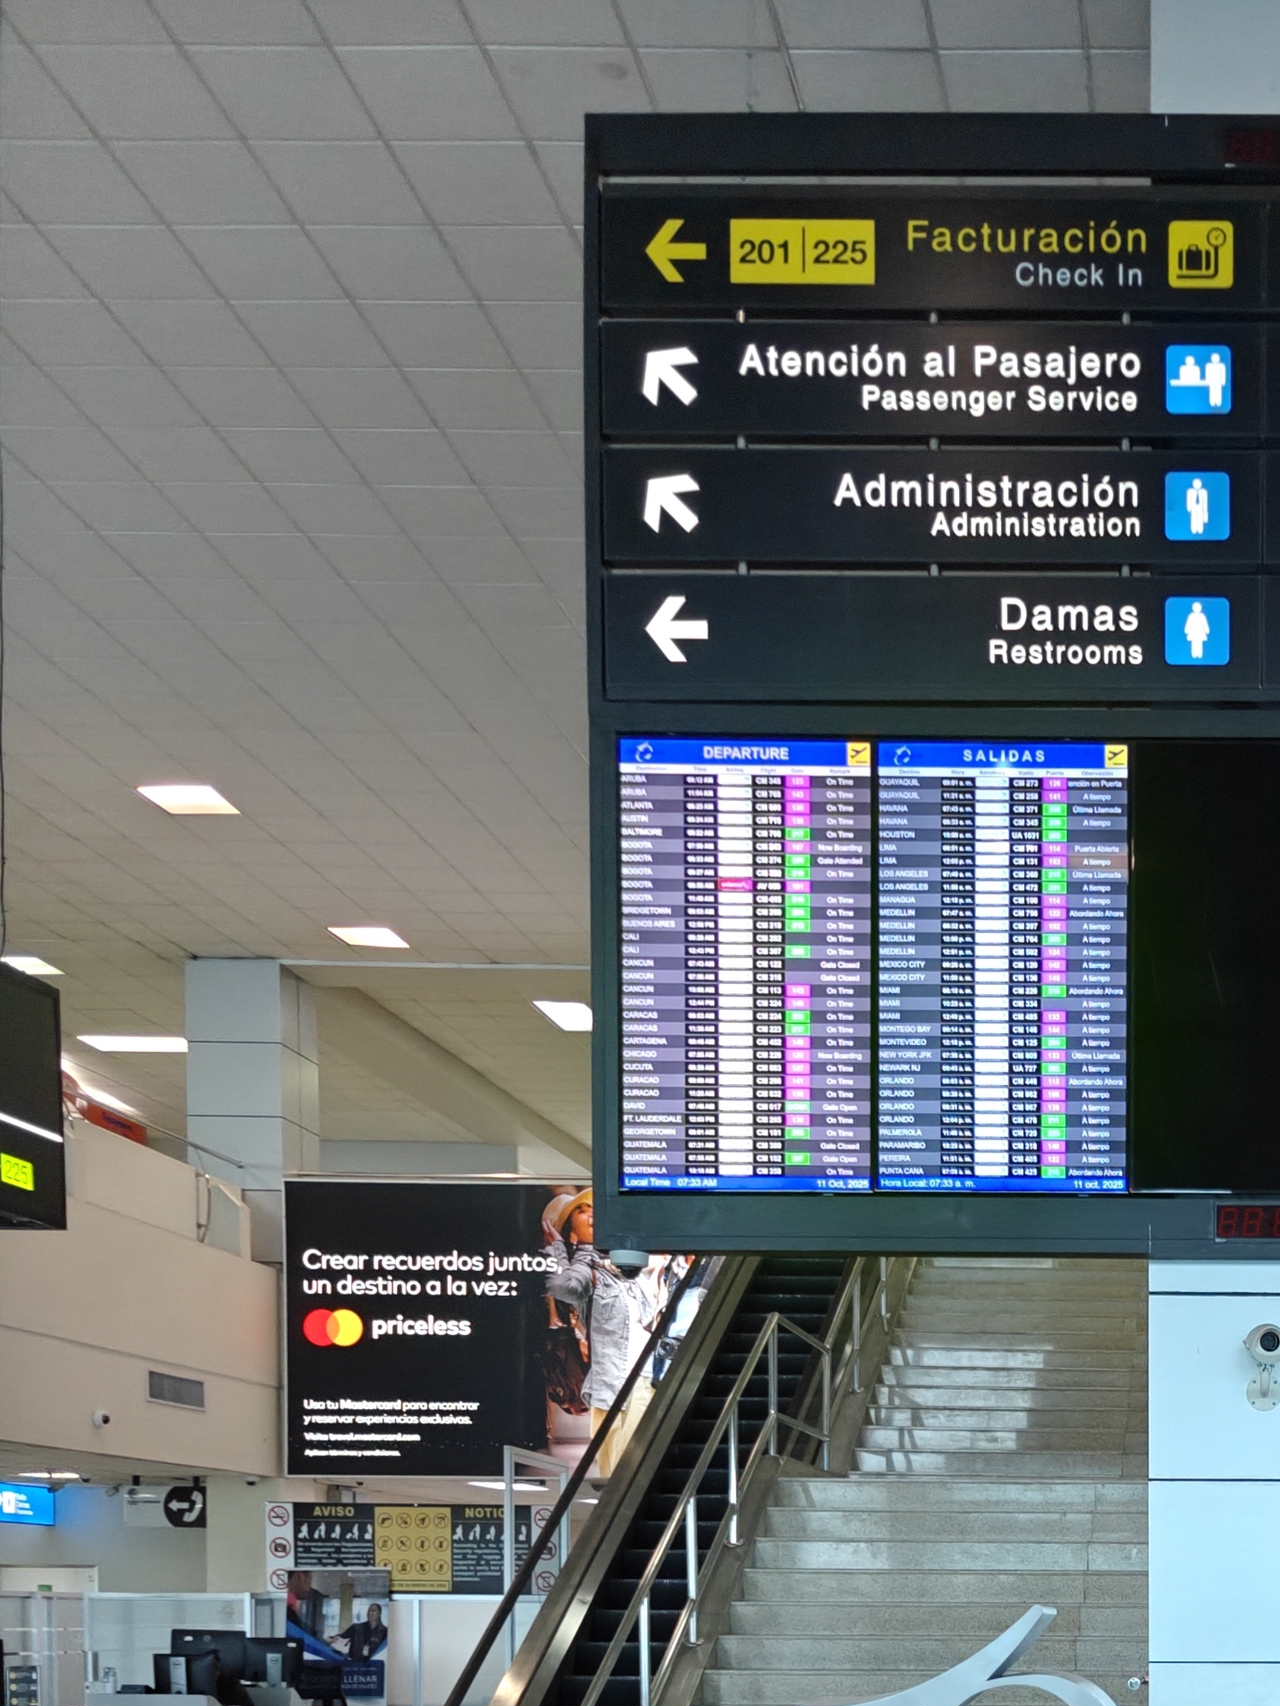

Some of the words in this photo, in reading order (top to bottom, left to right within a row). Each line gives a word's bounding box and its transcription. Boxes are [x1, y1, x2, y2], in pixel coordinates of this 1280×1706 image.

[906, 221, 1147, 253] Facturación
[738, 240, 790, 264] 201
[813, 240, 867, 264] 225
[1016, 263, 1103, 287] Check
[1118, 263, 1142, 287] In
[738, 344, 906, 376] Atención
[924, 346, 956, 376] al
[973, 346, 1141, 383] Pasajero
[861, 386, 1015, 417] Passenger
[1028, 386, 1137, 412] Service
[834, 473, 1138, 508] Administración
[931, 513, 1140, 537] Administration
[1000, 598, 1138, 631] Damas
[989, 640, 1142, 665] Restrooms
[703, 745, 789, 760] DEPARTURE
[963, 749, 1045, 762] SALIDAS
[5, 1160, 27, 1185] 225
[625, 1178, 648, 1187] Local
[651, 1178, 670, 1187] Time
[677, 1178, 701, 1187] 07:33
[703, 1178, 717, 1187] AM
[302, 1249, 368, 1270] Crear
[373, 1250, 484, 1271] recuerdos
[487, 1252, 563, 1276] juntos,
[303, 1278, 332, 1295] un
[337, 1275, 421, 1296] destino
[426, 1280, 441, 1296] a
[447, 1275, 467, 1296] la
[472, 1280, 518, 1296] vez:
[372, 1315, 472, 1340] priceless
[327, 1401, 338, 1410] tu
[340, 1399, 401, 1410] Mastercard
[403, 1402, 428, 1412] para
[429, 1401, 480, 1411] encontrar
[313, 1506, 355, 1517] AVISO
[465, 1507, 504, 1518] NOTIC
[343, 1675, 377, 1683] LLENAR
